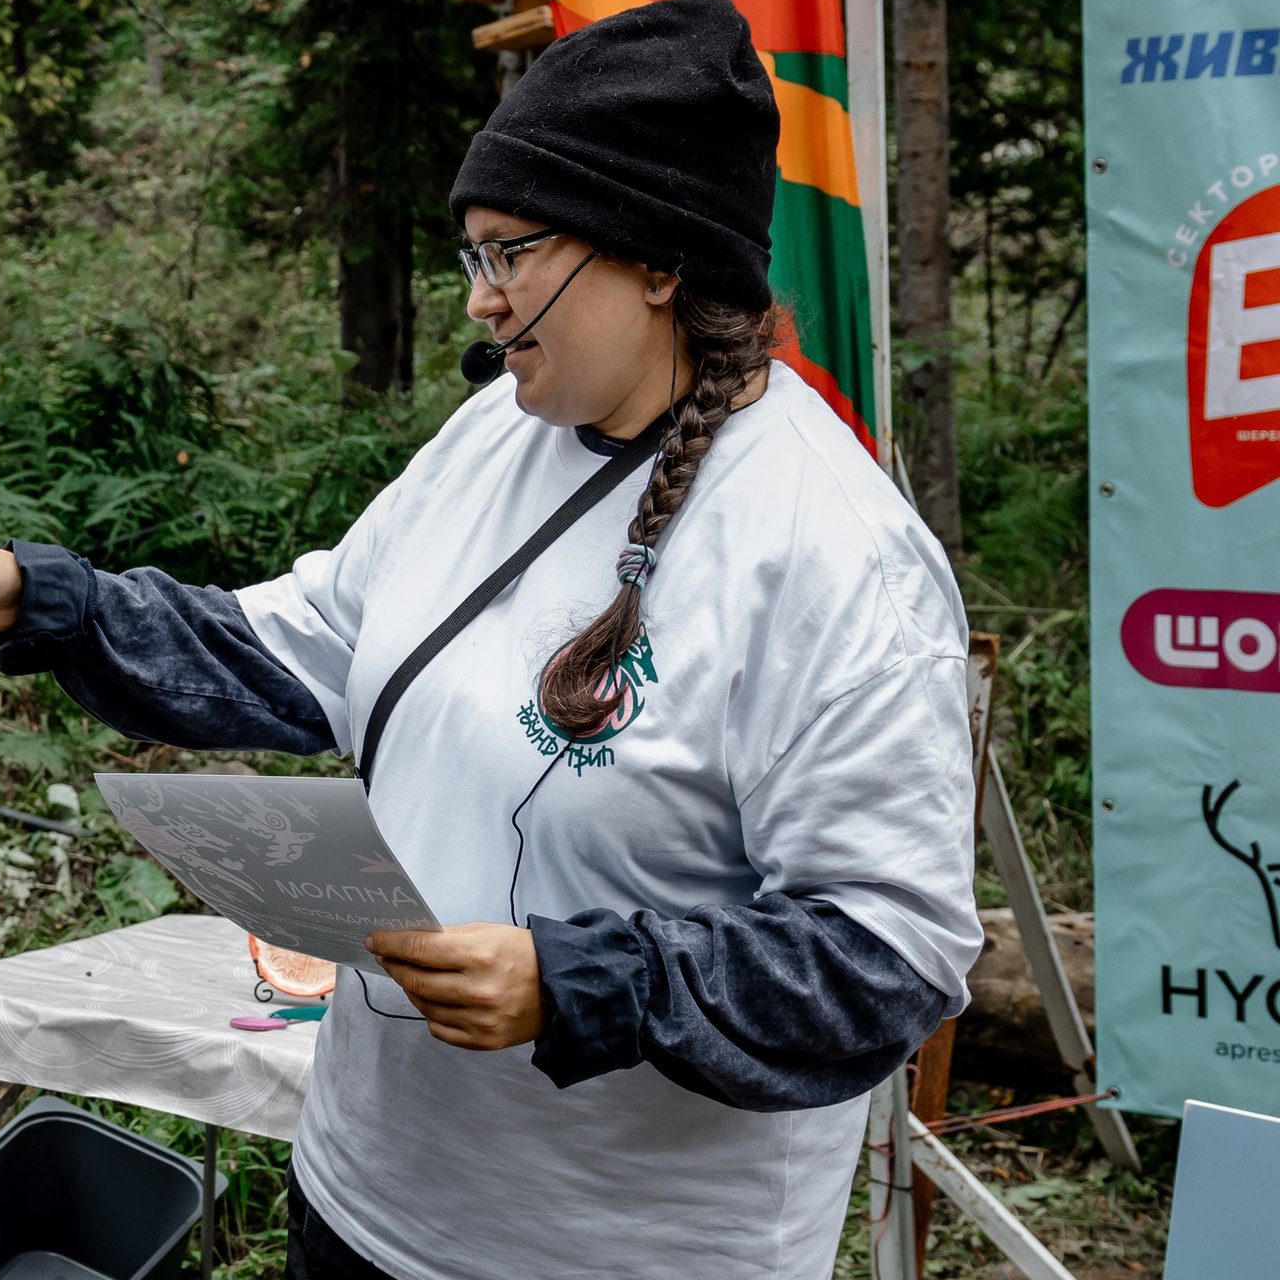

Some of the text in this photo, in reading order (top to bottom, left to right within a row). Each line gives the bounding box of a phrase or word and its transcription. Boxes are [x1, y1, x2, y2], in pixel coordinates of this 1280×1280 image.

[1120, 28, 1280, 84] ЖИВ
[1166, 152, 1279, 269] СЕКТОР
[1153, 613, 1280, 673] ШО
